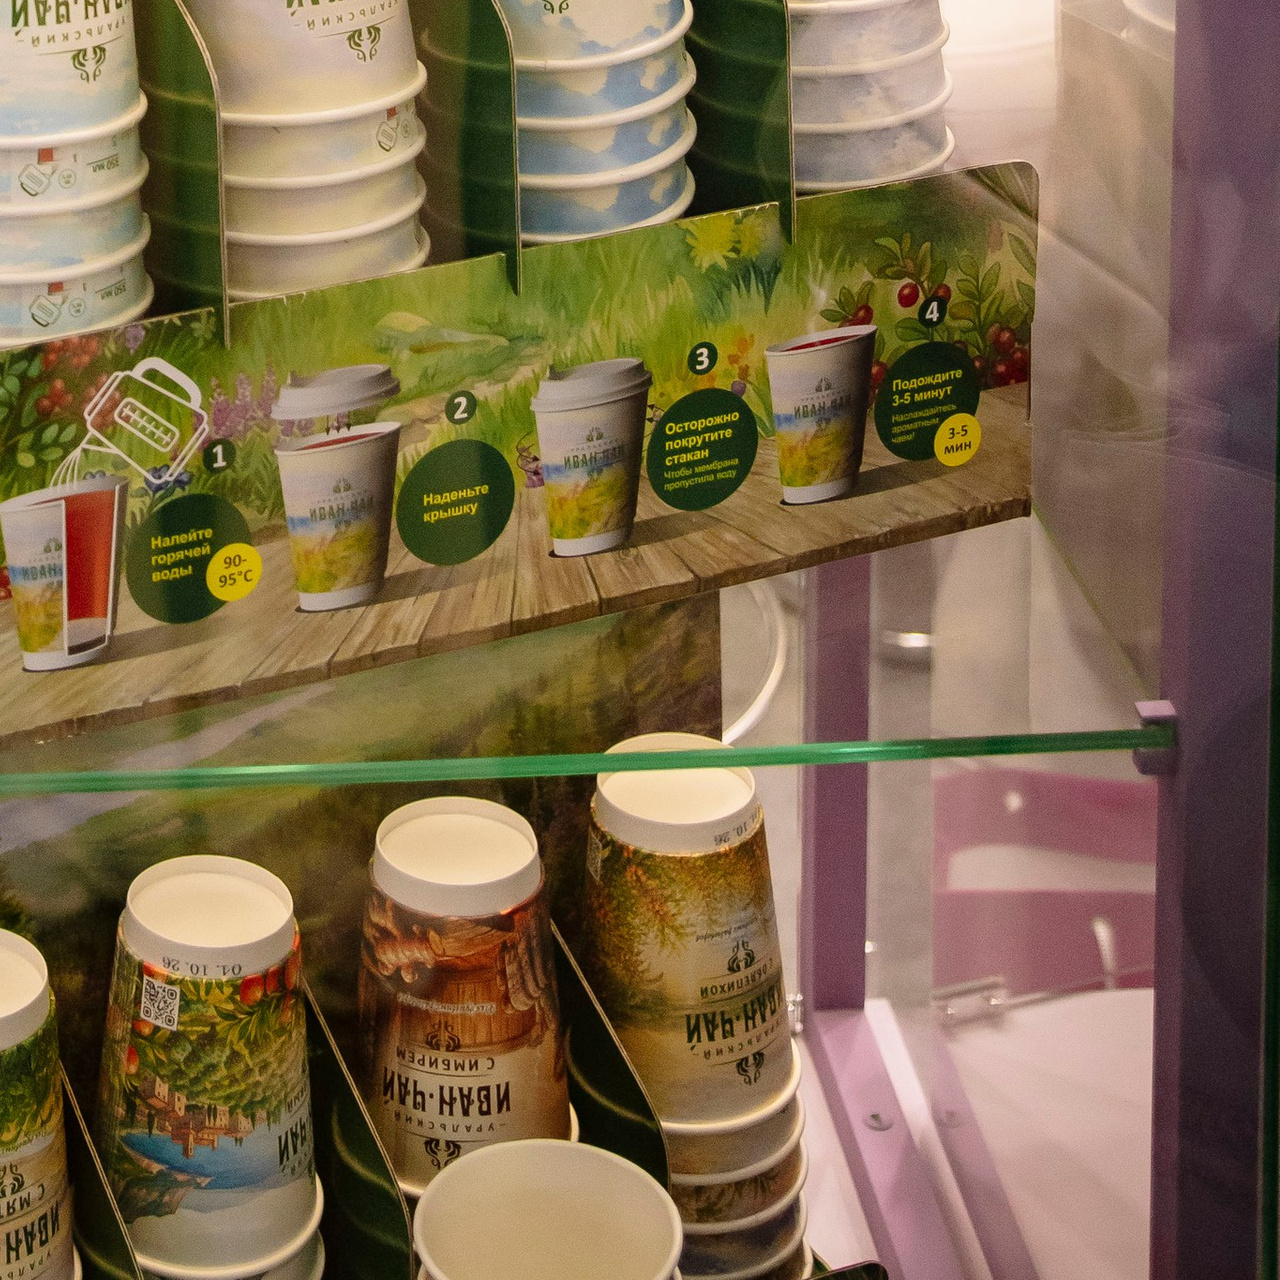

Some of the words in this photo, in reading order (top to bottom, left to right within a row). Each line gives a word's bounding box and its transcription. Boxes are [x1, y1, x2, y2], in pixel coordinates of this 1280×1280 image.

[925, 301, 939, 322] 4
[695, 348, 710, 370] 3
[892, 368, 963, 391] Подождите
[892, 392, 911, 407] 3-5
[914, 386, 953, 402] минут
[453, 396, 468, 420] 2
[665, 412, 740, 435] Осторожно
[948, 425, 968, 440] 3-5
[665, 428, 733, 451] покрутите
[944, 441, 972, 455] мин
[212, 444, 227, 468] 1
[665, 448, 710, 467] стакан
[664, 468, 692, 479] Чтобы
[694, 457, 739, 473] мембрана
[664, 474, 715, 490] пропустила
[423, 483, 489, 507] Наденьте
[423, 501, 478, 522] крышку
[151, 528, 213, 549] Налейте
[151, 542, 211, 566] горячей
[223, 554, 247, 569] 90-
[151, 565, 193, 582] воды
[396, 1046, 479, 1072] ИМБИРЕМ
[487, 1057, 495, 1070] С
[394, 1111, 495, 1133] УРАЛЬСКИЙ
